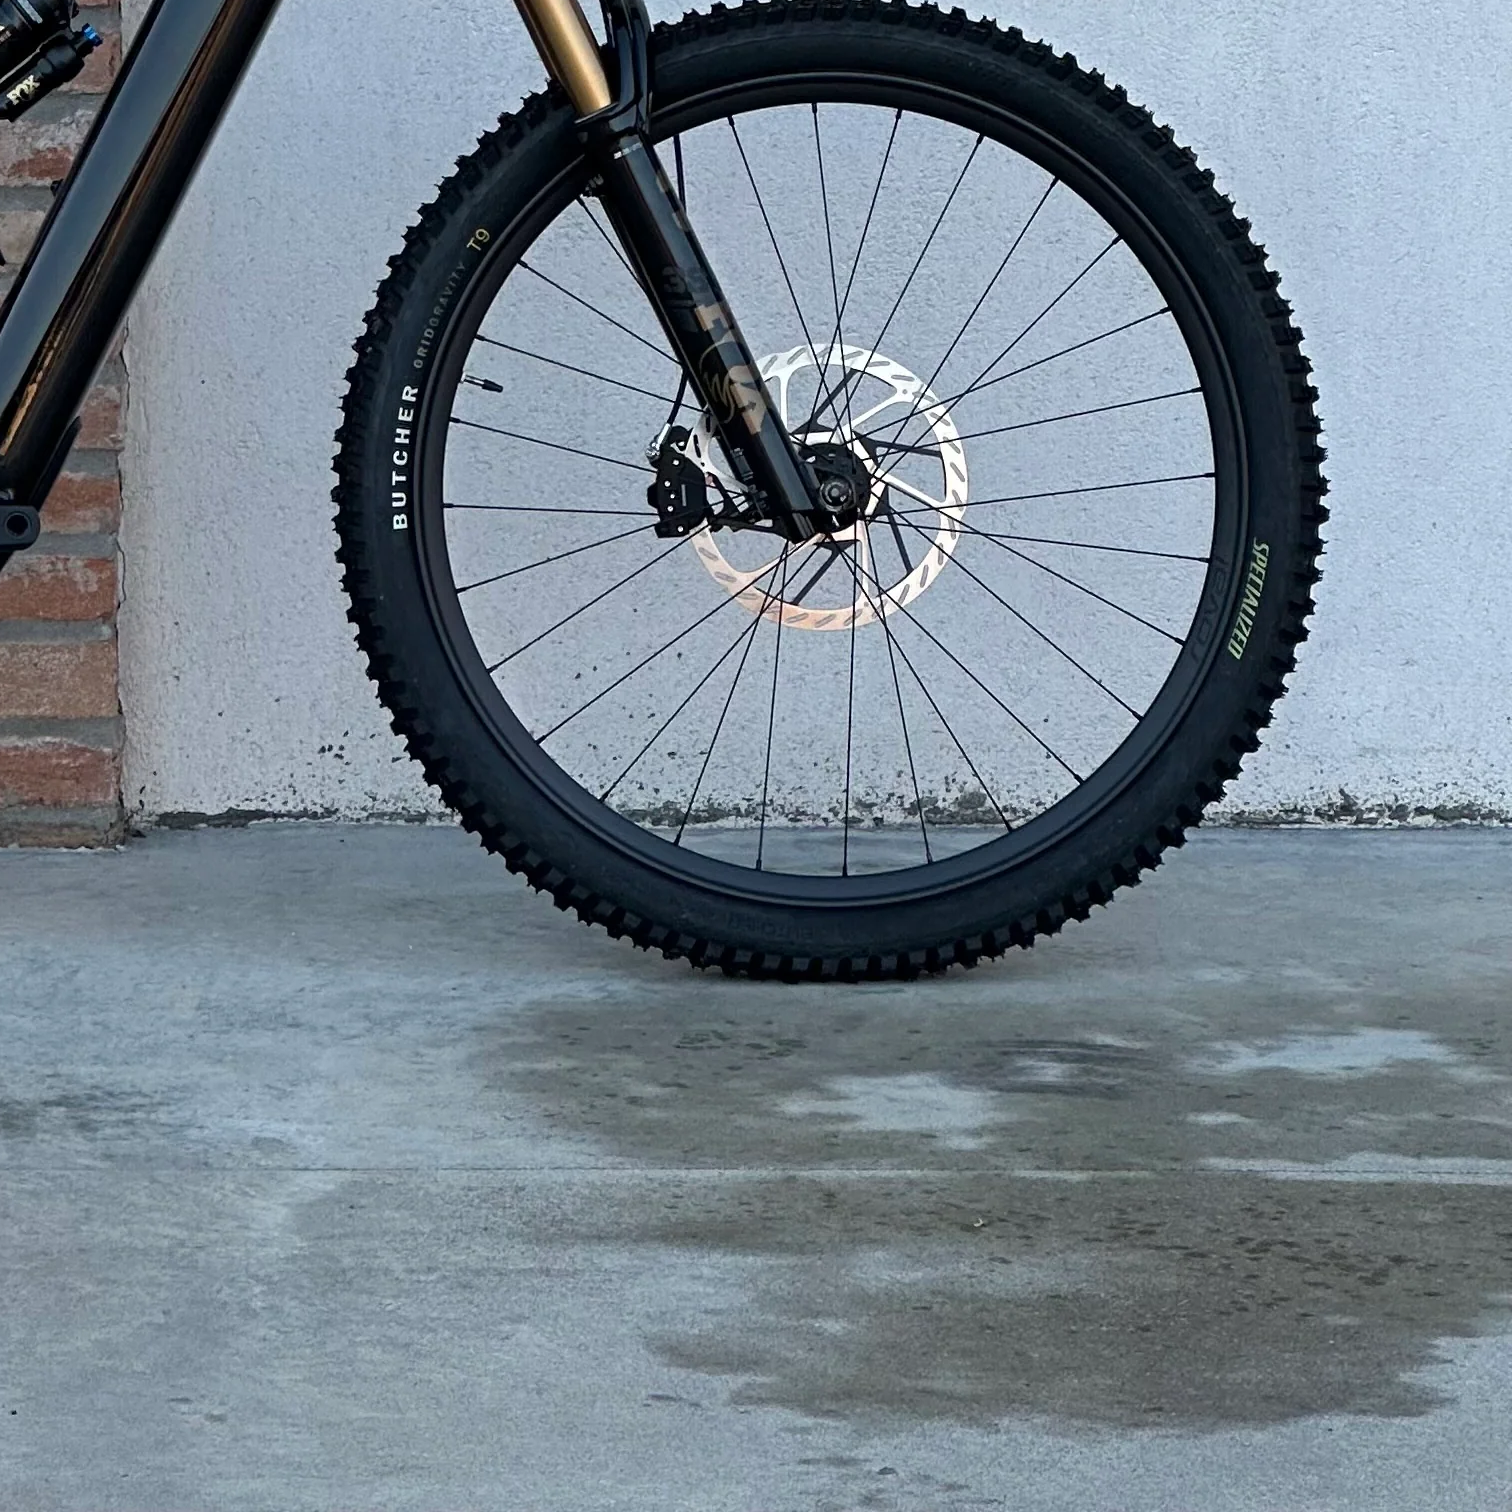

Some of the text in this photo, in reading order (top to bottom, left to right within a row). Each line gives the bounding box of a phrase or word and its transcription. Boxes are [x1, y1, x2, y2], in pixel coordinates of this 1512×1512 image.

[6, 74, 41, 106] FOX
[466, 228, 491, 251] T9
[392, 384, 418, 530] BUTCHER
[1228, 537, 1269, 660] SPECIALIZED
